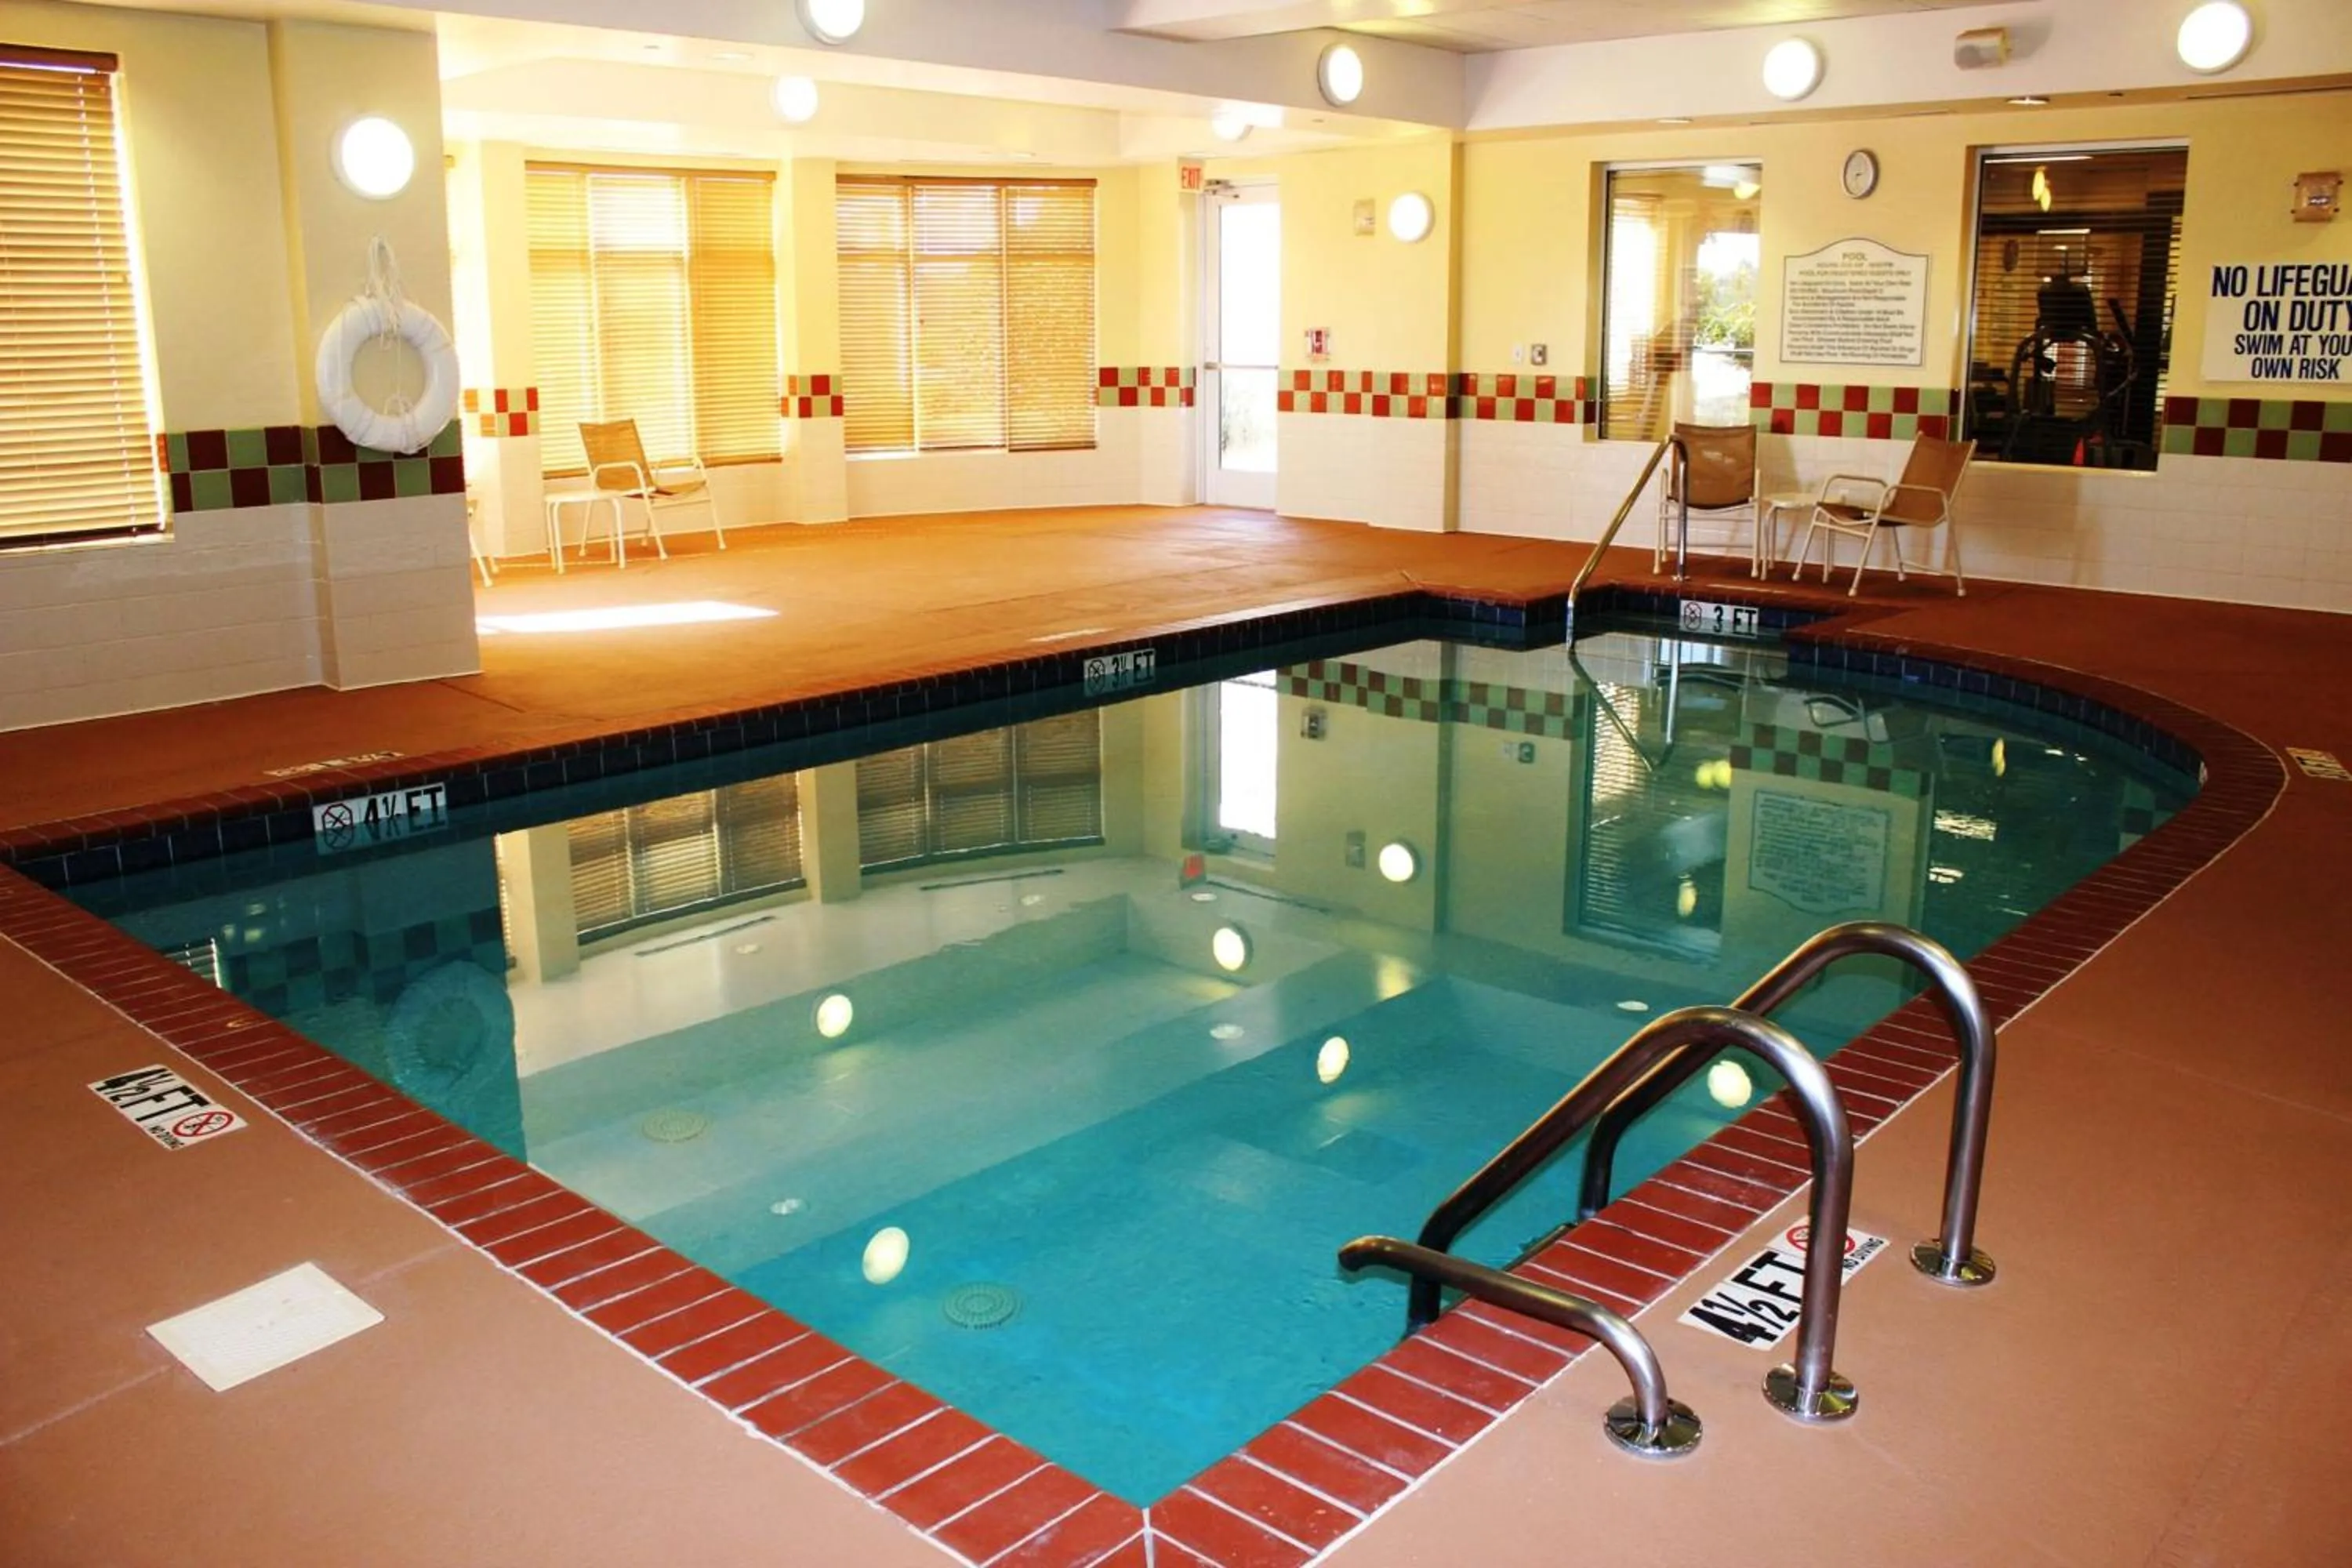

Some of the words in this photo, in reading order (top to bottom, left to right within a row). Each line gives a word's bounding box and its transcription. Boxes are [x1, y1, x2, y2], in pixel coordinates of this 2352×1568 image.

[1181, 166, 1201, 191] EXIT
[1842, 252, 1867, 262] POOL
[2212, 265, 2248, 297] NO
[2243, 300, 2280, 332] ON
[2234, 334, 2284, 355] SWIM
[2289, 334, 2312, 355] AT
[2251, 358, 2292, 379] OWN
[2299, 358, 2342, 379] RISK
[1733, 608, 1756, 633] FT
[405, 786, 443, 826] FT
[119, 1085, 210, 1123] FT
[1731, 1250, 1805, 1304] FT
